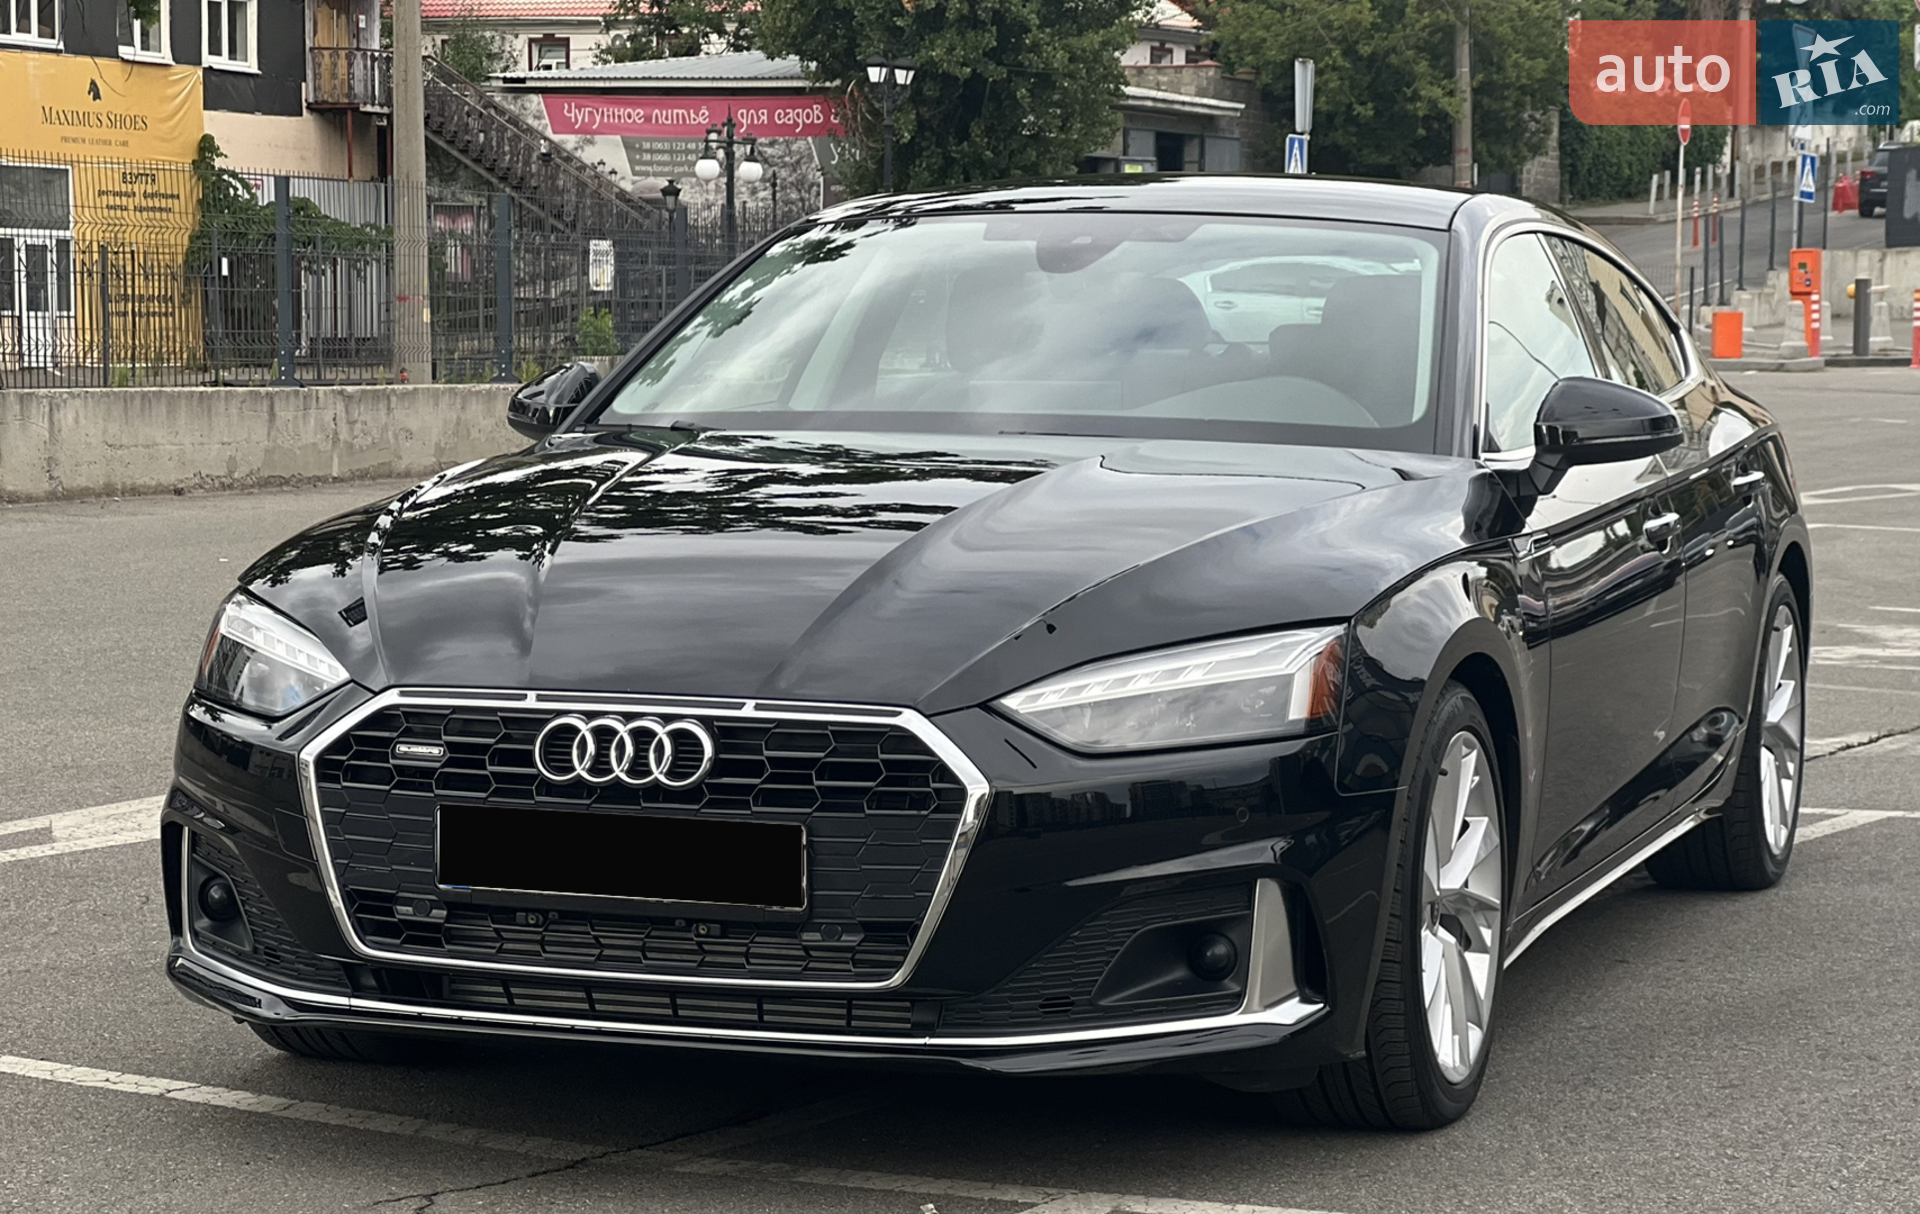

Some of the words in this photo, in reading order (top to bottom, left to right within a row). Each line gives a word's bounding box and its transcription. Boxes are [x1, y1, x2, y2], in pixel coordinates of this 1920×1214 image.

[106, 110, 148, 131] SHOES
[564, 102, 645, 129] Чугунное
[652, 105, 709, 124] литьё
[737, 108, 768, 133] для
[774, 104, 824, 133] садов
[672, 142, 686, 150] 123
[687, 142, 696, 150] 48
[672, 153, 686, 161] 123
[122, 172, 156, 185] ВЗУТТЯ
